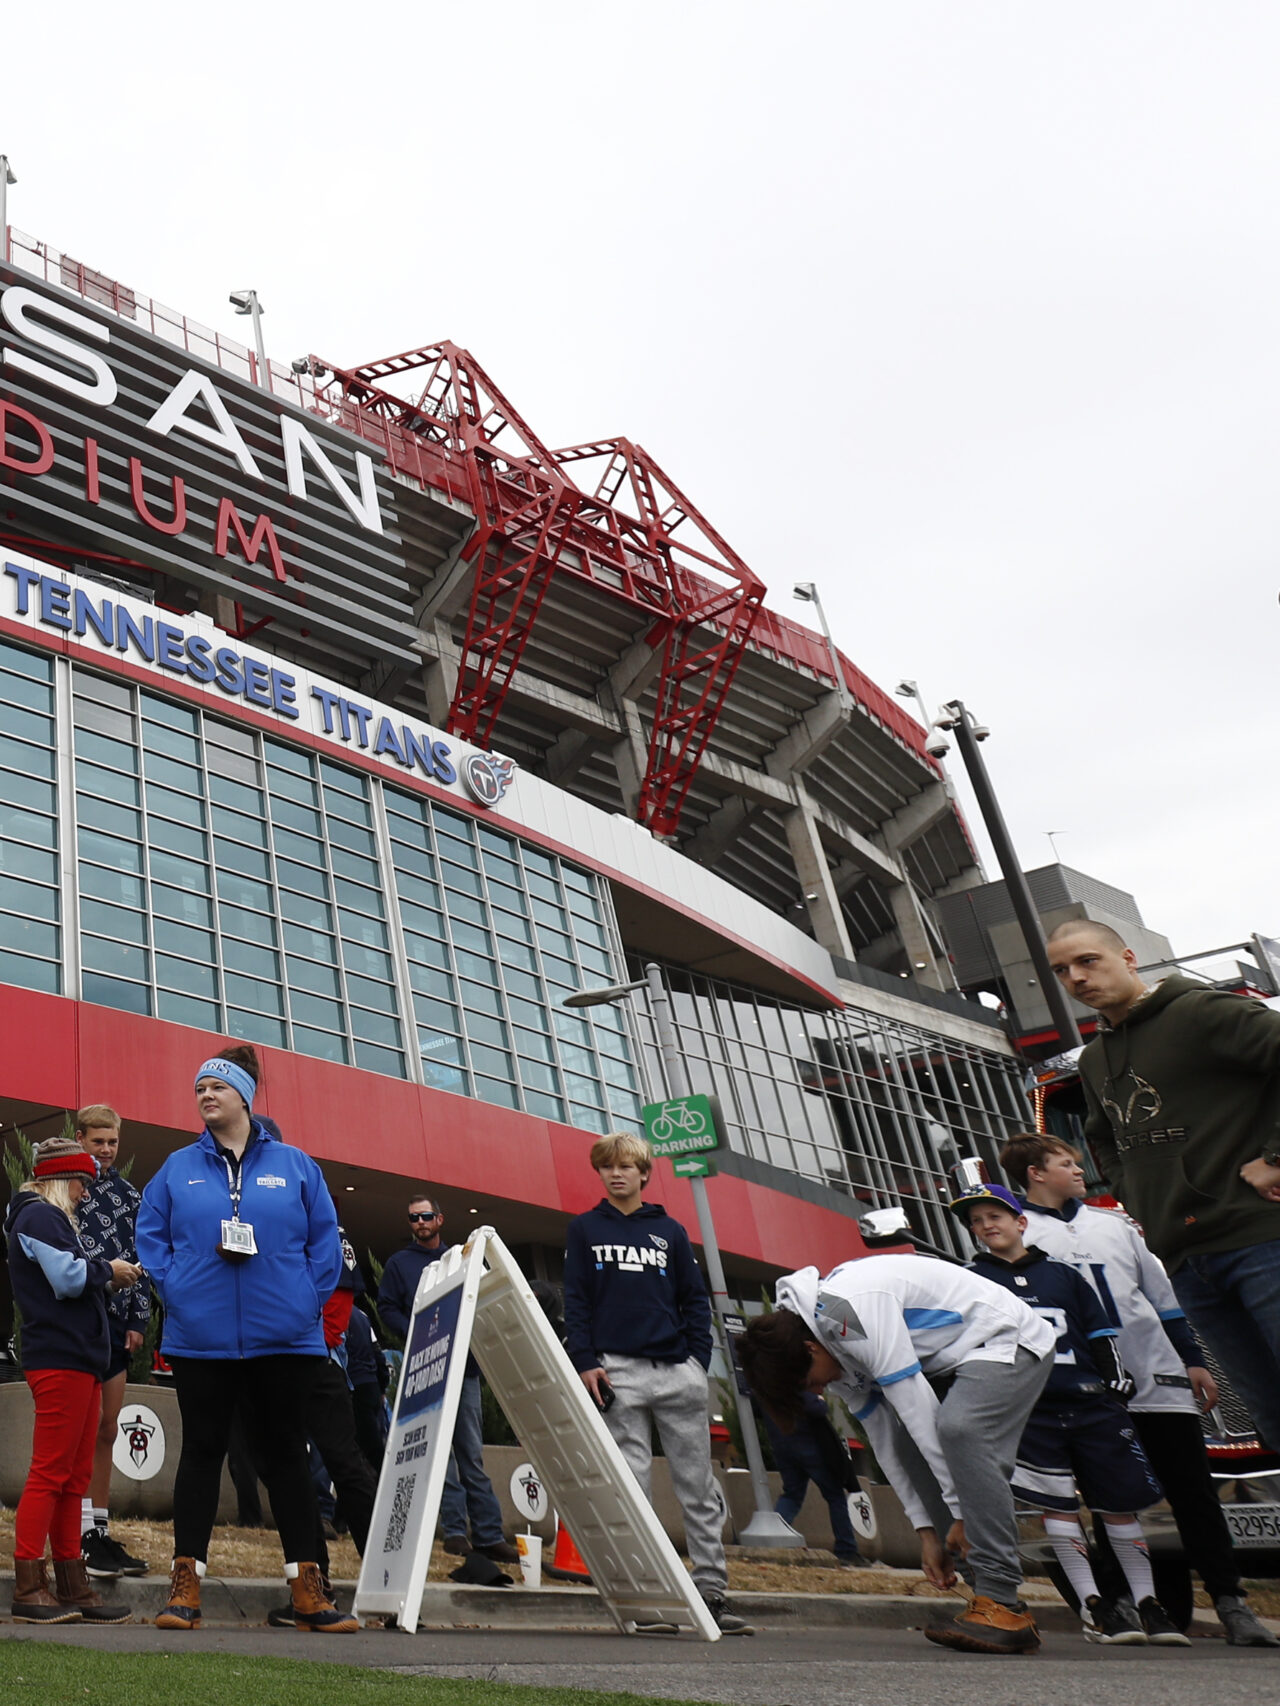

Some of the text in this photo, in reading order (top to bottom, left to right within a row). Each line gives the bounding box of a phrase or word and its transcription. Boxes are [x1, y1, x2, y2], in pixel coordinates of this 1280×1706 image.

[5, 562, 300, 720] TENNESSEE
[311, 685, 459, 786] TITANS
[652, 1134, 714, 1155] PARKING
[81, 1198, 99, 1215] TITANS
[591, 1244, 668, 1269] TITANS
[428, 1356, 447, 1388] DASH
